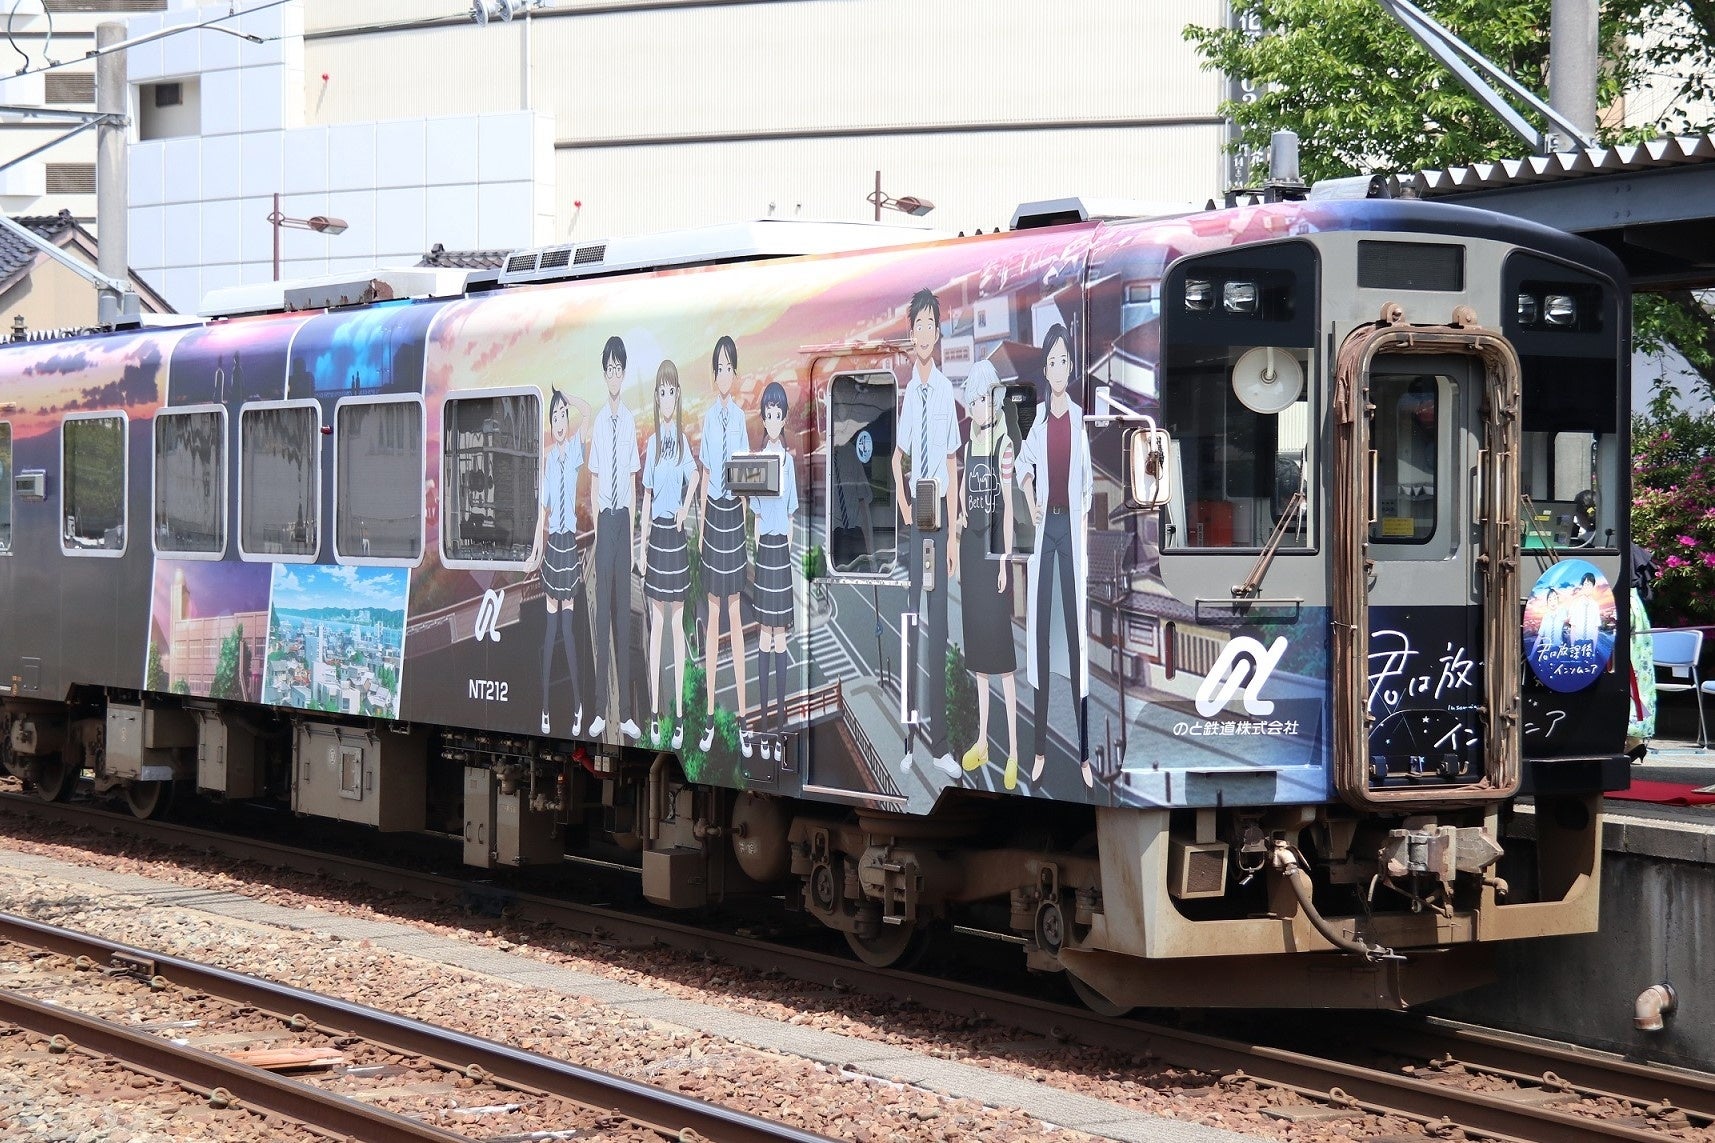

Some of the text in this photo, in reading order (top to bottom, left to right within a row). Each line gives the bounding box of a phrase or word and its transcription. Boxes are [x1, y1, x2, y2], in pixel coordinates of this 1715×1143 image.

[1553, 664, 1598, 675] インソムニア
[468, 678, 509, 702] NT212
[1172, 720, 1300, 736] のと鉄道株式会社
